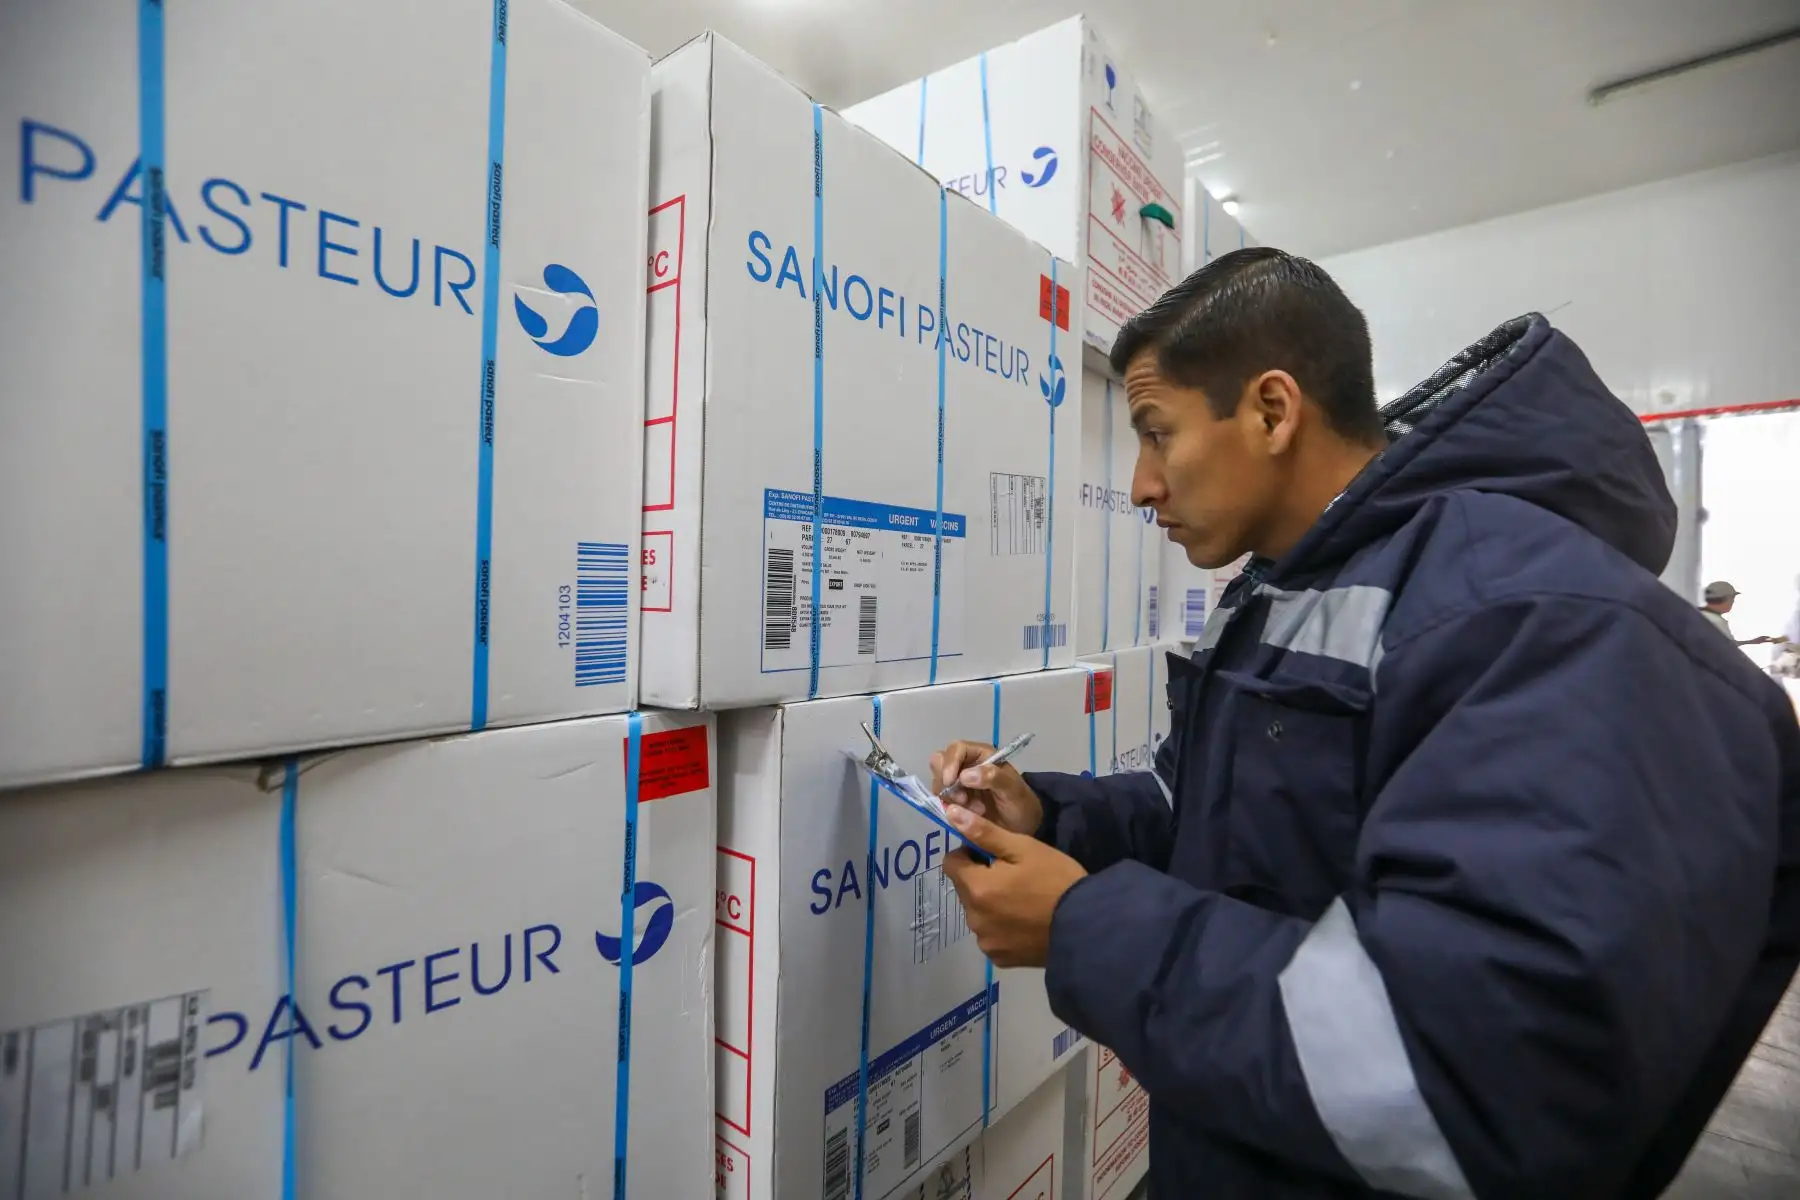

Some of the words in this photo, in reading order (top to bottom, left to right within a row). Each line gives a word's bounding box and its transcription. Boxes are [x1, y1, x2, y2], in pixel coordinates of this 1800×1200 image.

[493, 162, 502, 201] sanofi
[19, 117, 477, 315] PASTEUR
[491, 201, 500, 250] pasteur
[747, 230, 906, 338] SANOFI
[919, 304, 1030, 387] PASTEUR
[487, 359, 496, 399] sanofi
[484, 399, 493, 447] pasteur
[802, 495, 824, 503] PASTR
[1079, 483, 1093, 508] FI
[888, 513, 919, 527] URGENT
[930, 519, 959, 532] VACINS
[481, 559, 490, 598] sanofi
[480, 599, 489, 647] pasteur
[558, 585, 572, 648] 1204103
[810, 828, 949, 915] SANOFI
[203, 923, 562, 1072] PASTEUR
[930, 1016, 957, 1039] URGENT
[966, 996, 987, 1015] VACCI
